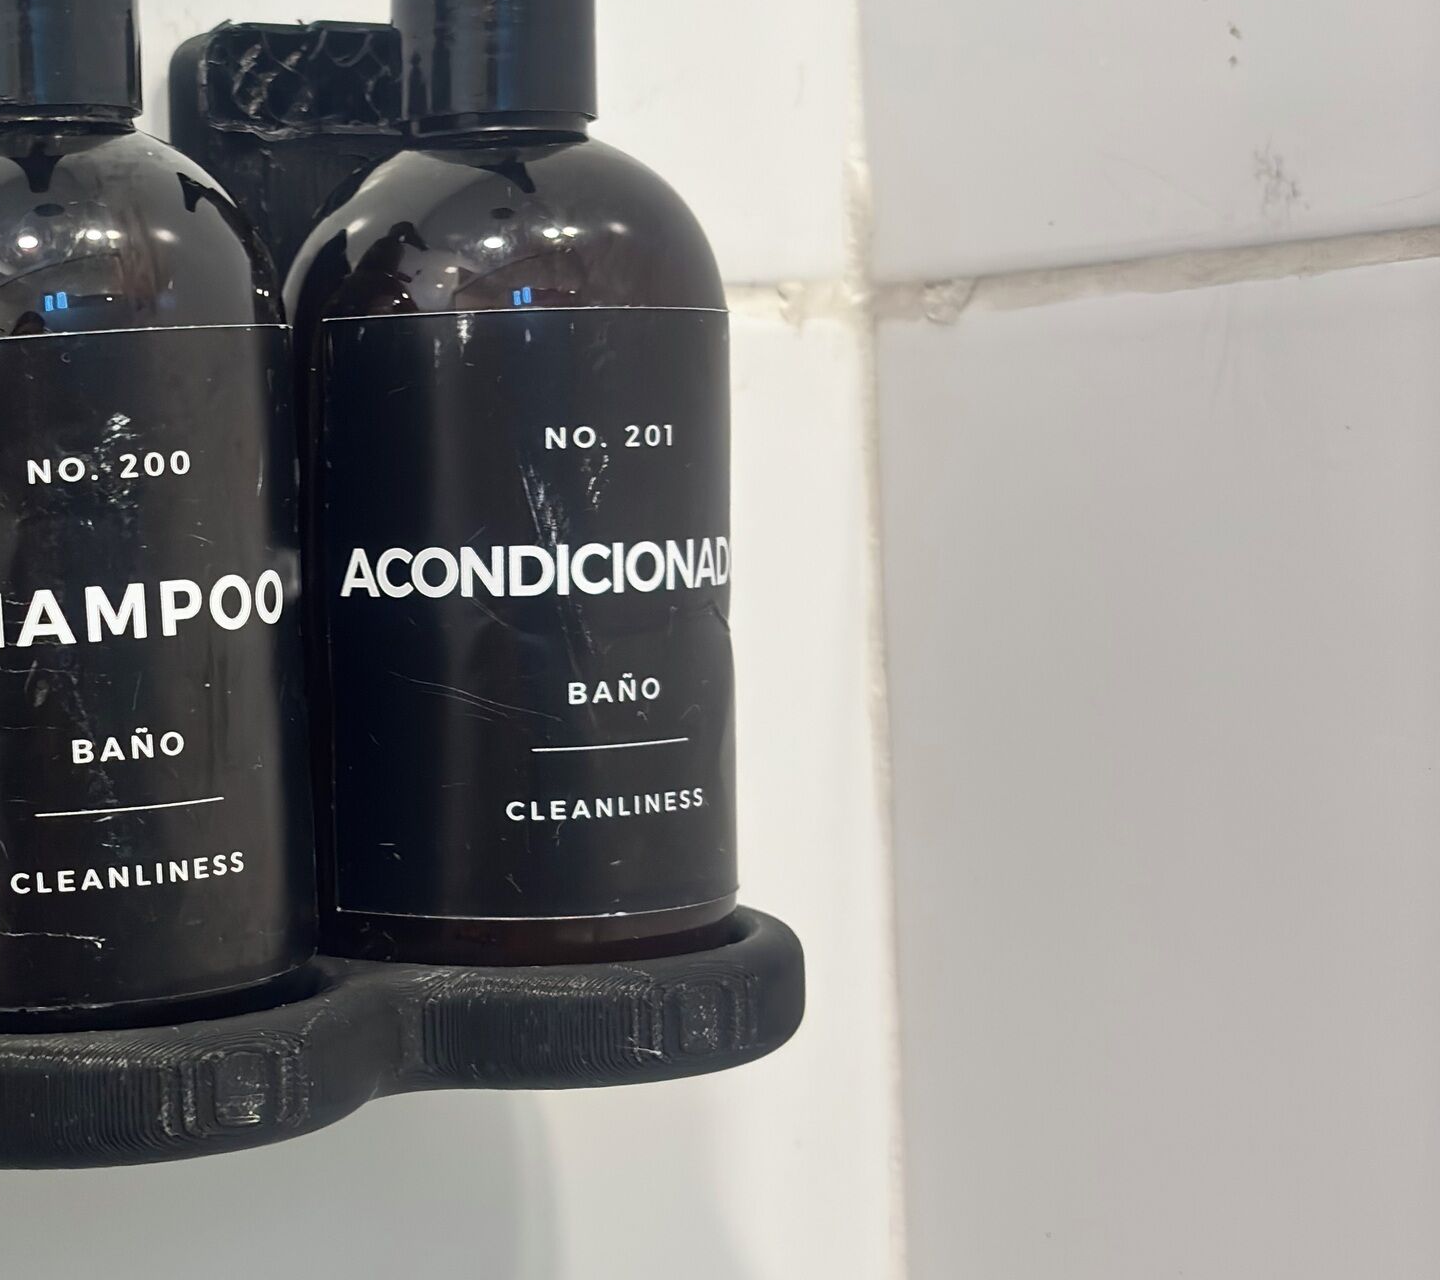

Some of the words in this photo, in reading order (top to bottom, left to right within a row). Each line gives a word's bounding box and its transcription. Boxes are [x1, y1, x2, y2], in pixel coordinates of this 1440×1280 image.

[544, 425, 607, 450] NO.
[625, 424, 674, 447] 201
[27, 456, 98, 484] NO.
[119, 450, 191, 479] 200
[568, 672, 660, 705] BAÑO
[71, 726, 185, 764] BAÑO
[505, 787, 704, 821] CLEANLINESS
[10, 851, 245, 894] CLEANLINESS
